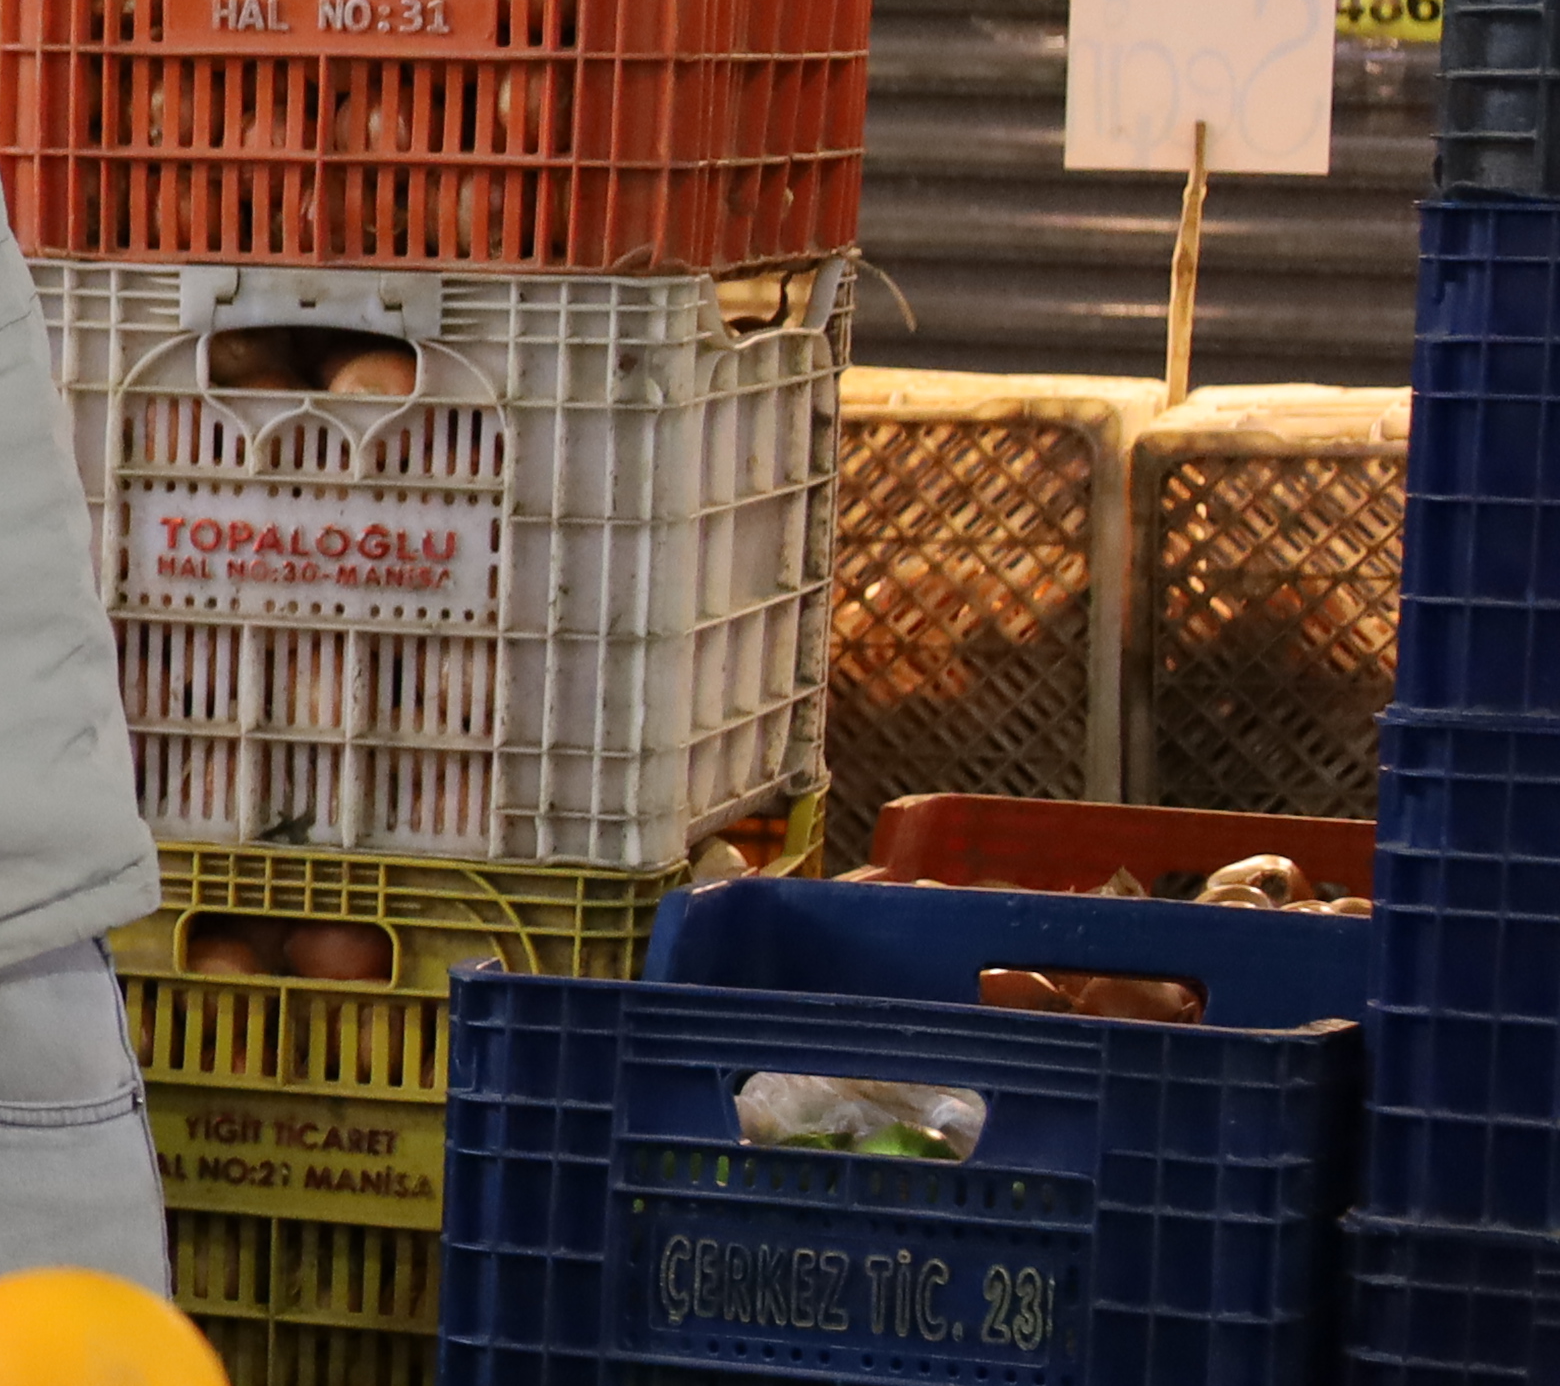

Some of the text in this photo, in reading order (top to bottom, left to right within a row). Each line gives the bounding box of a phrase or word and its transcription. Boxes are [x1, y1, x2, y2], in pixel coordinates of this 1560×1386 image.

[156, 554, 214, 580] HAL
[659, 1234, 850, 1332] ÇERKEZ
[864, 1247, 965, 1343] TİC.
